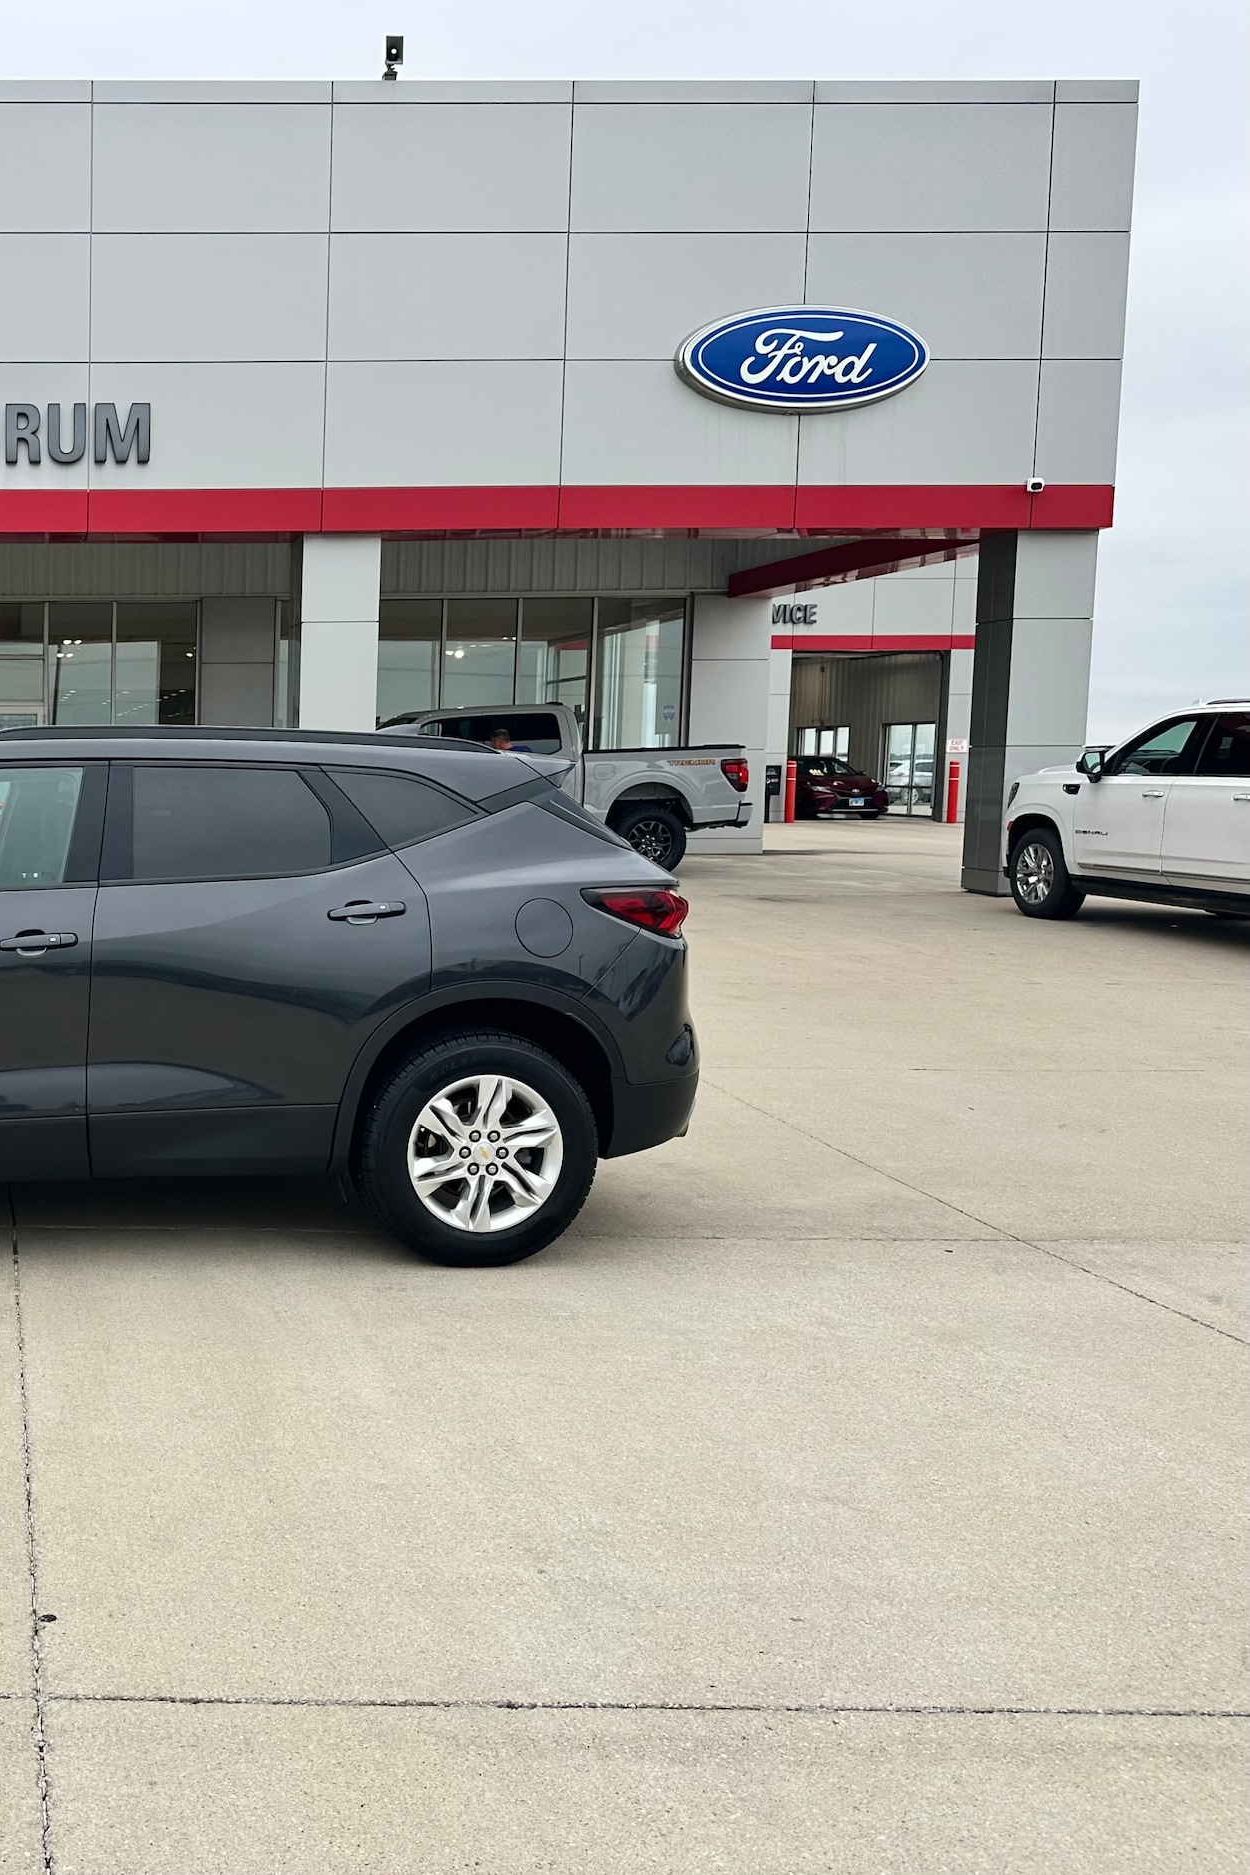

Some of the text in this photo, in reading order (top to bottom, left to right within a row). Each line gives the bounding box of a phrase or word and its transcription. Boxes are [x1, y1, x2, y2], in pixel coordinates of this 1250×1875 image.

[740, 328, 877, 384] Ford
[771, 603, 817, 624] VICE
[666, 759, 716, 767] TREMOR
